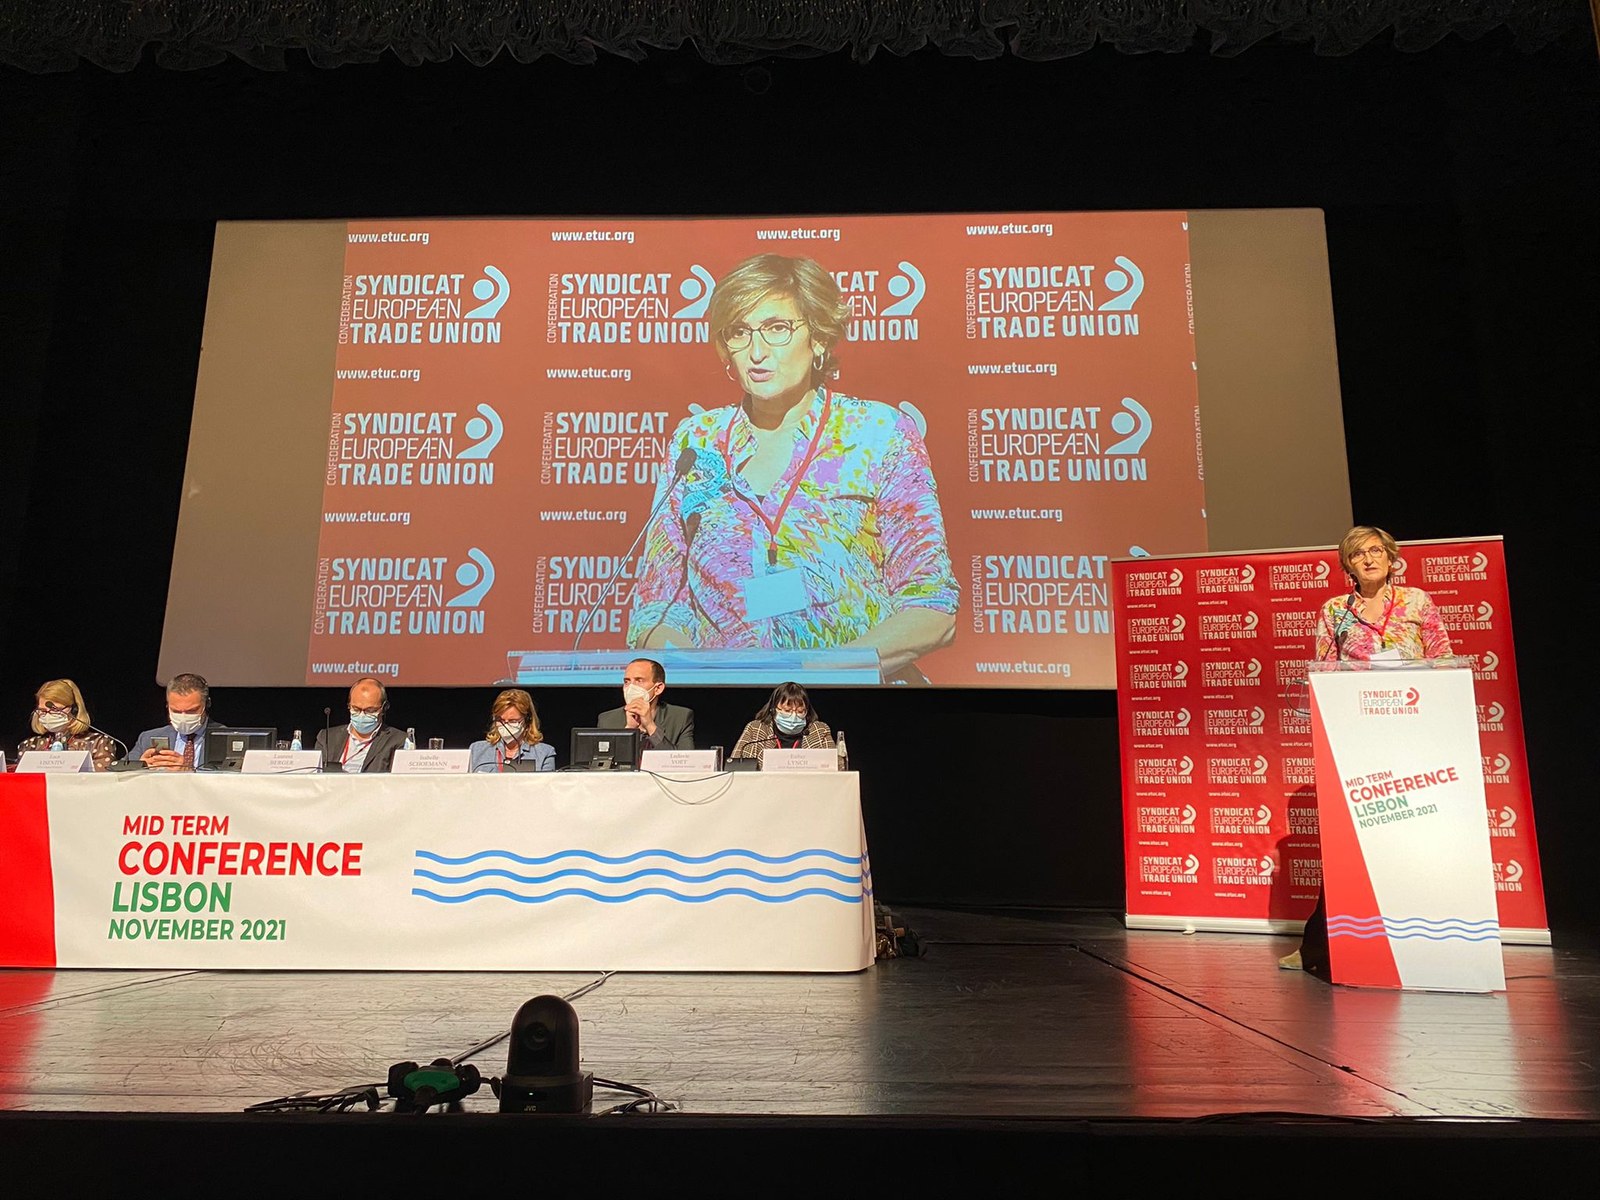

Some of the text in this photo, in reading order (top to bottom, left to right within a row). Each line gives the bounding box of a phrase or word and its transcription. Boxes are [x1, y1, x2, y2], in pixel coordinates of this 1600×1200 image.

[552, 230, 634, 243] www.etuc.org
[756, 228, 840, 241] www.etuc.org
[966, 223, 1053, 236] www.etuc.org
[348, 232, 429, 244] www.etuc.org
[978, 265, 1095, 289] SYNDICAT
[355, 274, 465, 295] SYNDICAT
[561, 274, 671, 295] SYNDICAT
[338, 274, 353, 344] CONFEDERATION
[547, 274, 558, 344] CONFEDERATION
[966, 268, 976, 339] CONFEDERATION
[349, 322, 501, 344] TRADE UNION
[558, 322, 710, 343] TRADE UNION
[846, 319, 918, 341] UNION
[977, 314, 1139, 338] TRADE UNION
[337, 368, 420, 381] www.etuc.org
[546, 367, 631, 381] www.etuc.org
[968, 363, 1058, 376] www.etuc.org
[344, 412, 456, 435] SYNDICAT
[556, 412, 668, 434] SYNDICAT
[981, 407, 1100, 431] SYNDICAT
[326, 412, 342, 486] CONFEDERATION
[541, 412, 553, 485] CONFEDERATION
[968, 408, 978, 482] CONFEDERATION
[338, 462, 494, 485] TRADE UNION
[552, 462, 628, 484] TRADE
[980, 458, 1147, 482] TRADE UNION
[324, 511, 410, 525] www.etuc.org
[540, 509, 627, 523] www.etuc.org
[971, 508, 1063, 522] www.etuc.org
[985, 555, 1108, 579] SYNDICAT
[1426, 556, 1469, 565] SYNDICAT
[331, 557, 447, 581] SYNDICAT
[1200, 568, 1239, 577] SYNDICAT
[1273, 564, 1313, 573] SYNDICAT
[1130, 572, 1168, 580] SYNDICAT
[1427, 572, 1487, 582] TRADE UNION
[1156, 587, 1181, 595] UNION
[1200, 584, 1254, 593] TRADE UNION
[1273, 580, 1328, 590] TRADE UNION
[314, 557, 330, 635] CONFEDERATION
[533, 556, 546, 634] CONFEDERATION
[971, 555, 985, 633] CONFEDERATION
[326, 610, 485, 635] TRADE UNION
[544, 609, 621, 633] TRADE
[984, 610, 1067, 634] TRADE
[1132, 618, 1170, 626] SYNDICAT
[1203, 614, 1242, 623] SYNDICAT
[1276, 611, 1316, 620] SYNDICAT
[1463, 622, 1492, 630] UNION
[1203, 632, 1230, 640] TRADE
[312, 661, 399, 677] www.etuc.org
[976, 661, 1071, 677] www.etuc.org
[1134, 664, 1172, 672] SYNDICAT
[1205, 662, 1245, 671] SYNDICAT
[1234, 678, 1260, 686] UNION
[1363, 690, 1402, 698] SYNDICAT
[1136, 711, 1174, 719] SYNDICAT
[1208, 710, 1248, 718] SYNDICAT
[1364, 707, 1418, 715] TRADE UNION
[1136, 728, 1162, 736] TRADE
[1208, 727, 1235, 735] TRADE
[1138, 758, 1177, 767] SYNDICAT
[1211, 758, 1251, 766] SYNDICAT
[1139, 775, 1192, 784] TRADE UNION
[1211, 775, 1266, 784] TRADE UNION
[1345, 770, 1393, 788] MID TERM
[1350, 767, 1459, 803] CONFERENCE
[1141, 807, 1180, 815] SYNDICAT
[1214, 807, 1254, 816] SYNDICAT
[1354, 795, 1409, 818] LISBON
[1359, 804, 1438, 829] NOVEMBER 2021
[123, 815, 229, 836] MID TERM
[1141, 825, 1195, 833] TRADE UNION
[1214, 825, 1270, 834] TRADE UNION
[118, 841, 363, 876] CONFERENCE
[1143, 857, 1182, 865] SYNDICAT
[1217, 858, 1257, 867] SYNDICAT
[1144, 875, 1198, 883] TRADE UNION
[1217, 876, 1273, 885] TRADE UNION
[112, 881, 232, 913] LISBON
[108, 919, 286, 941] NOVEMBER 2021
